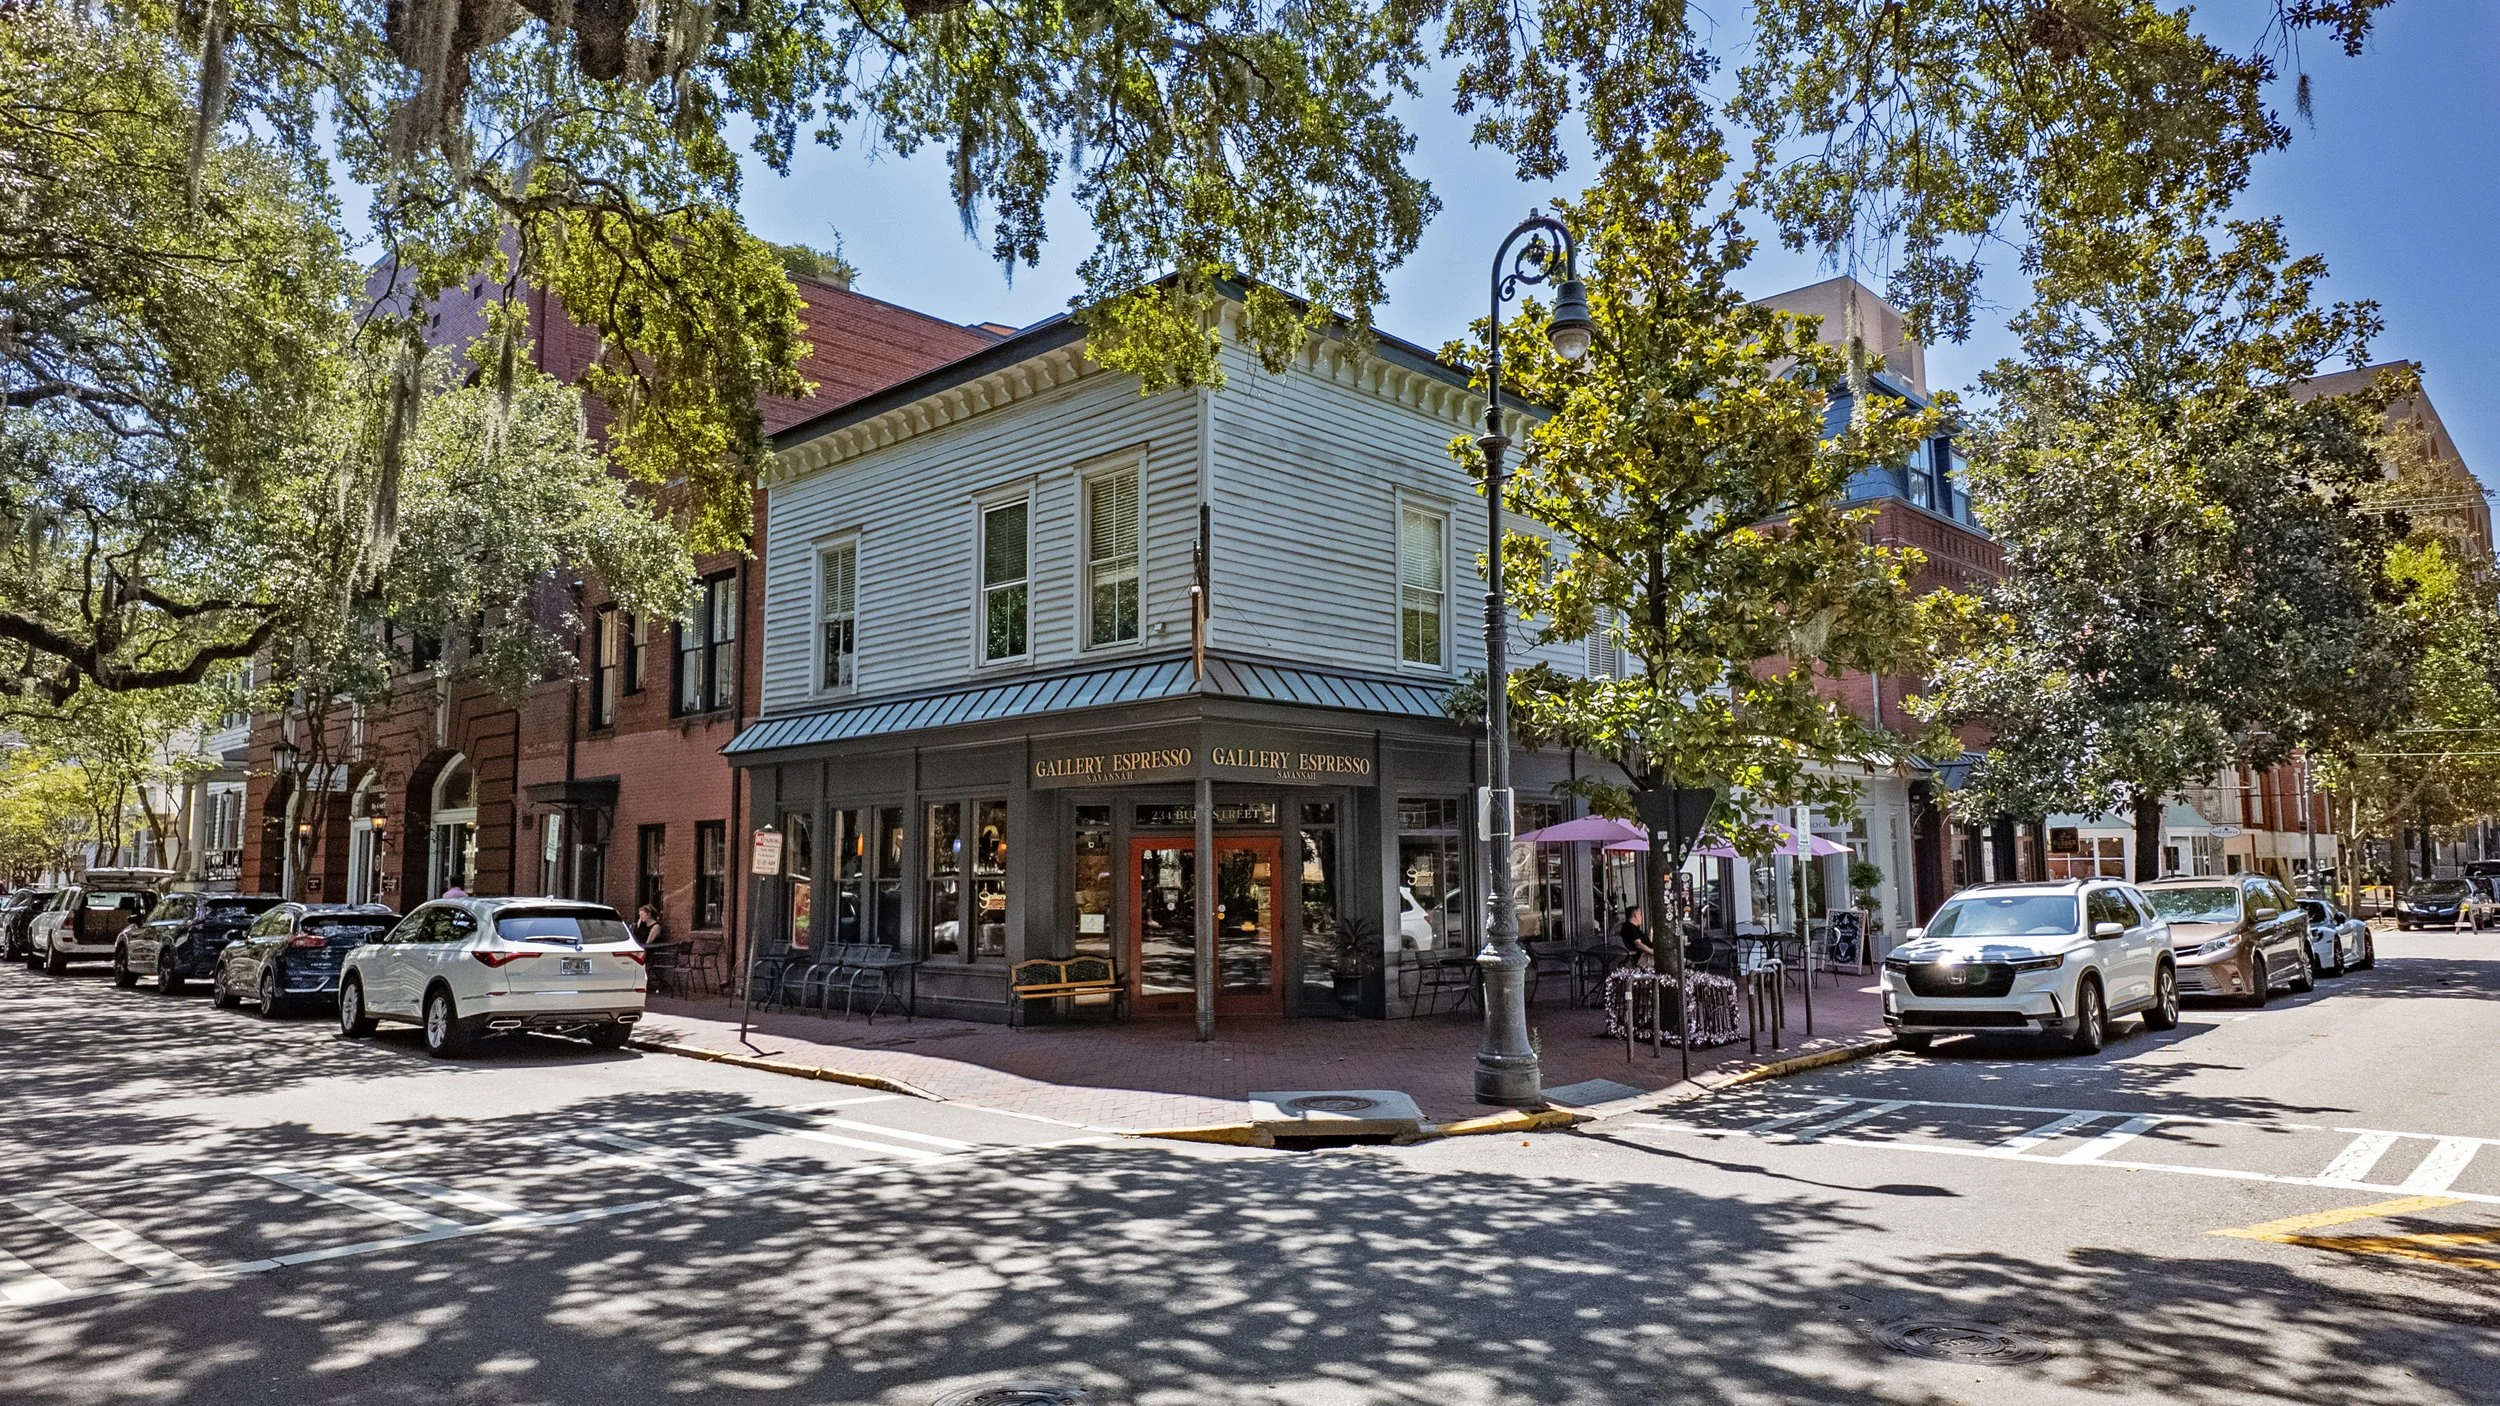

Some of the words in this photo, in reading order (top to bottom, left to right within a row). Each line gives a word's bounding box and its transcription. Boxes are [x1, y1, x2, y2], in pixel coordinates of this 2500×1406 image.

[1035, 755, 1105, 778] GALLERY
[1113, 747, 1192, 772] ESPRESSO
[1212, 747, 1290, 769] GALLERY
[1299, 753, 1370, 775] ESPRESSO
[1086, 771, 1133, 783] SAVANNAH
[1277, 770, 1316, 780] SAVANNAH
[1212, 809, 1260, 819] STREET
